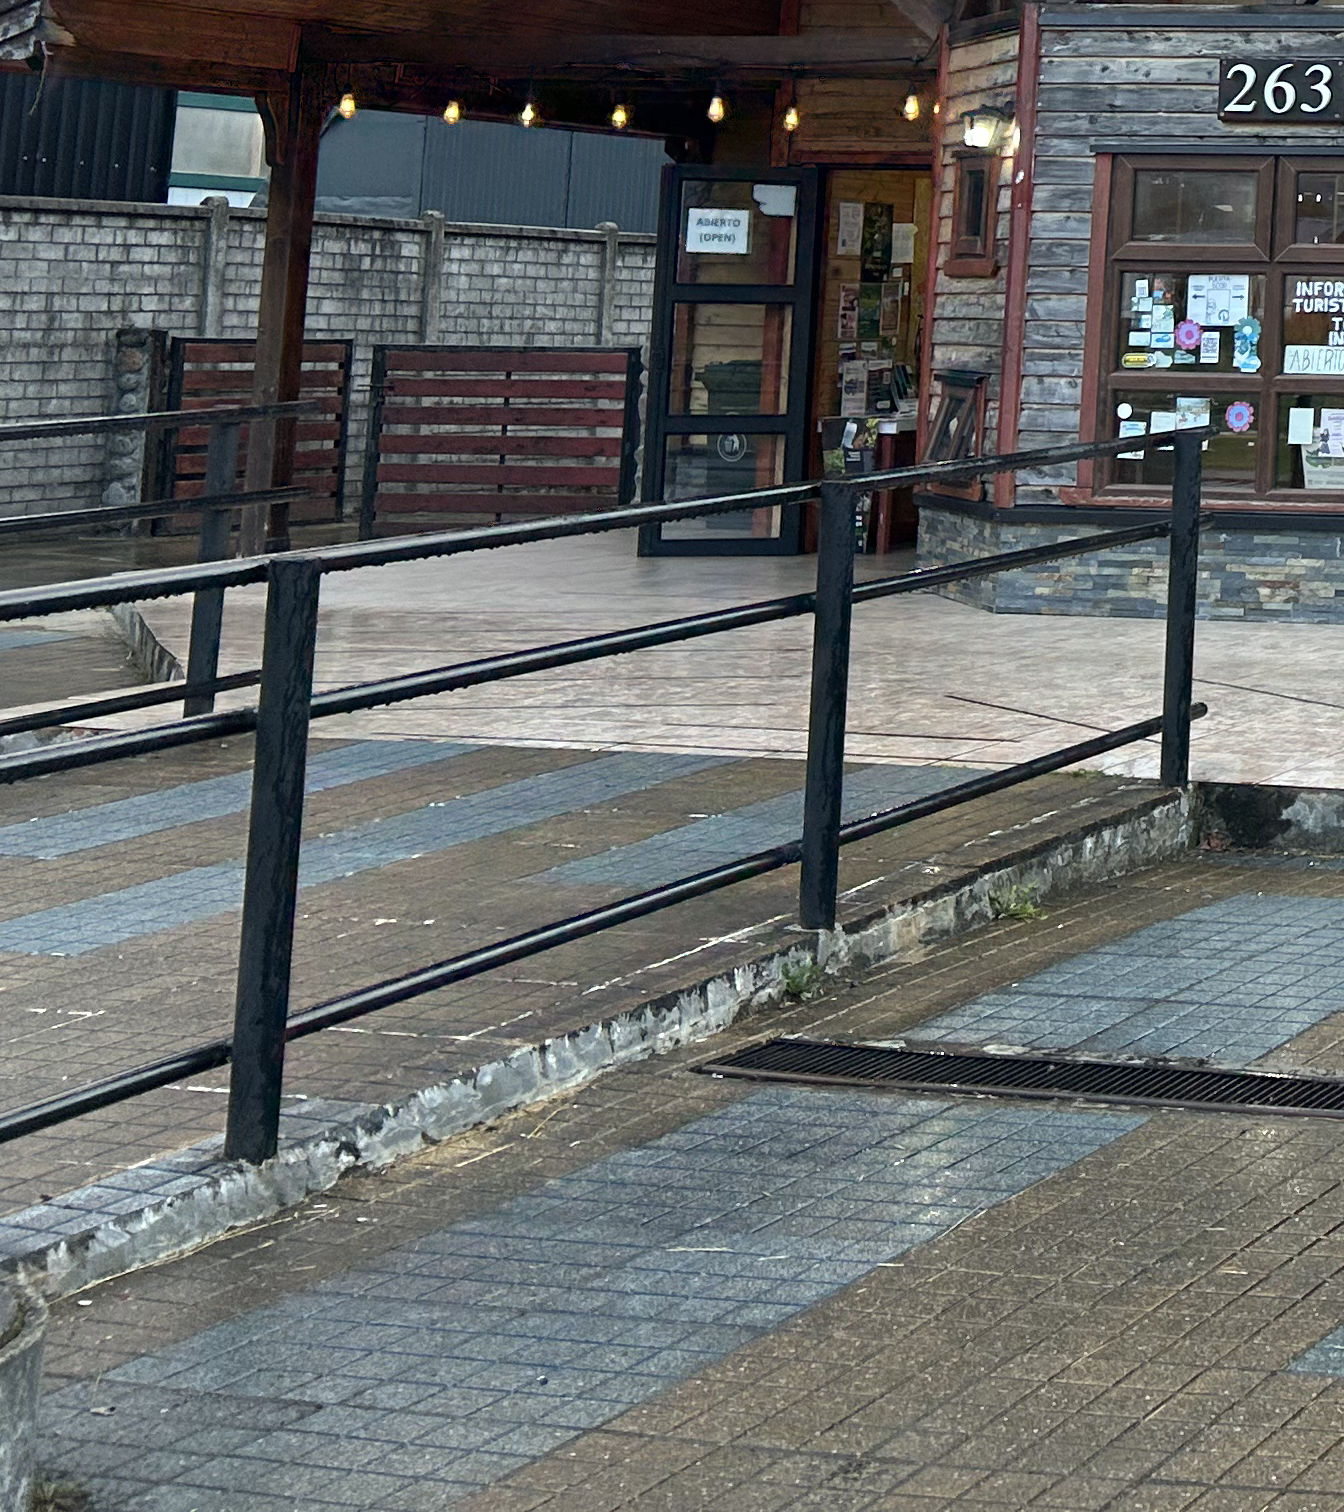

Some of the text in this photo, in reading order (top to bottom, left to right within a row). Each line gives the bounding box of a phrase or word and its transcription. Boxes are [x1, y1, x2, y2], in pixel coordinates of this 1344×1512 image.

[1224, 63, 1332, 113] 263
[696, 218, 741, 228] ABIERTO
[699, 233, 736, 244] (OPEN)
